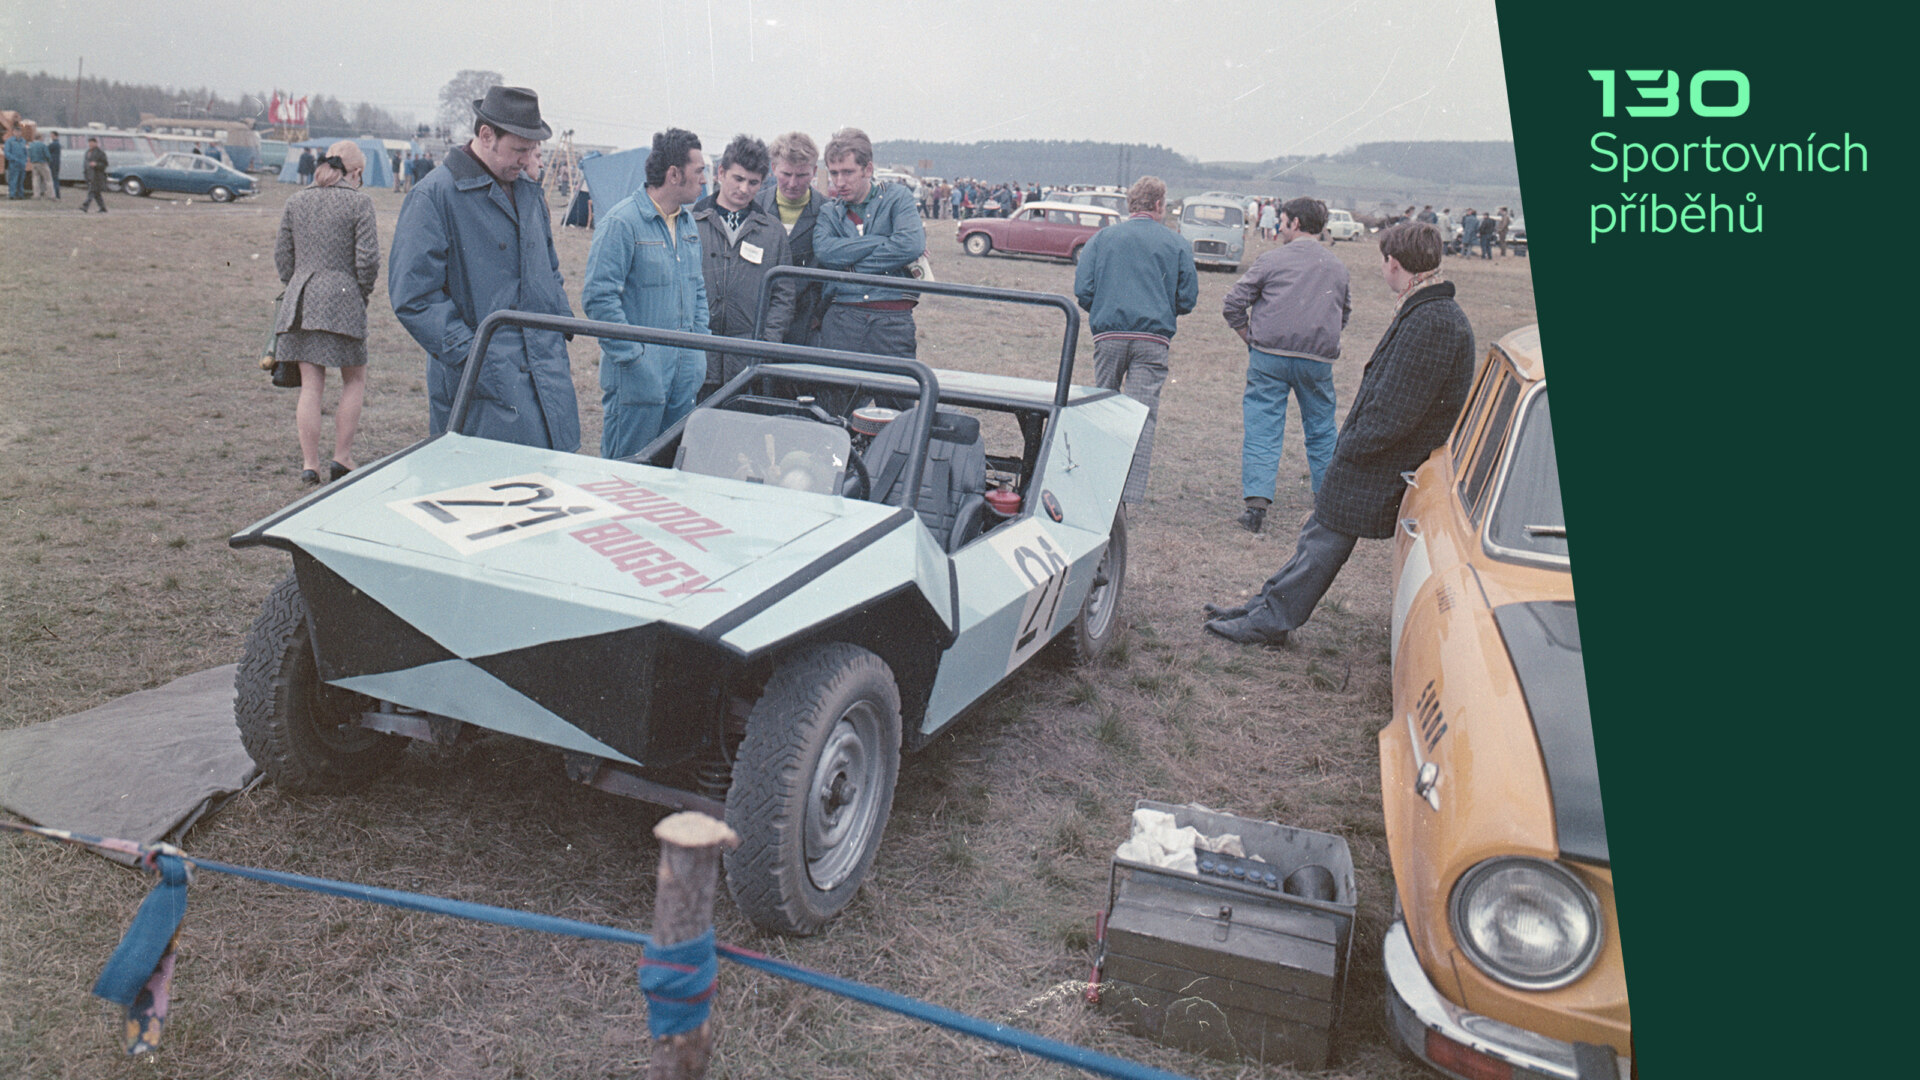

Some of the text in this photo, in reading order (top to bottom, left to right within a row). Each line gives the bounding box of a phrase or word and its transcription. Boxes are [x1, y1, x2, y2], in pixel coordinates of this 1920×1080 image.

[413, 482, 594, 541] 21
[569, 523, 727, 598] BUGGY
[1014, 535, 1068, 651] 21
